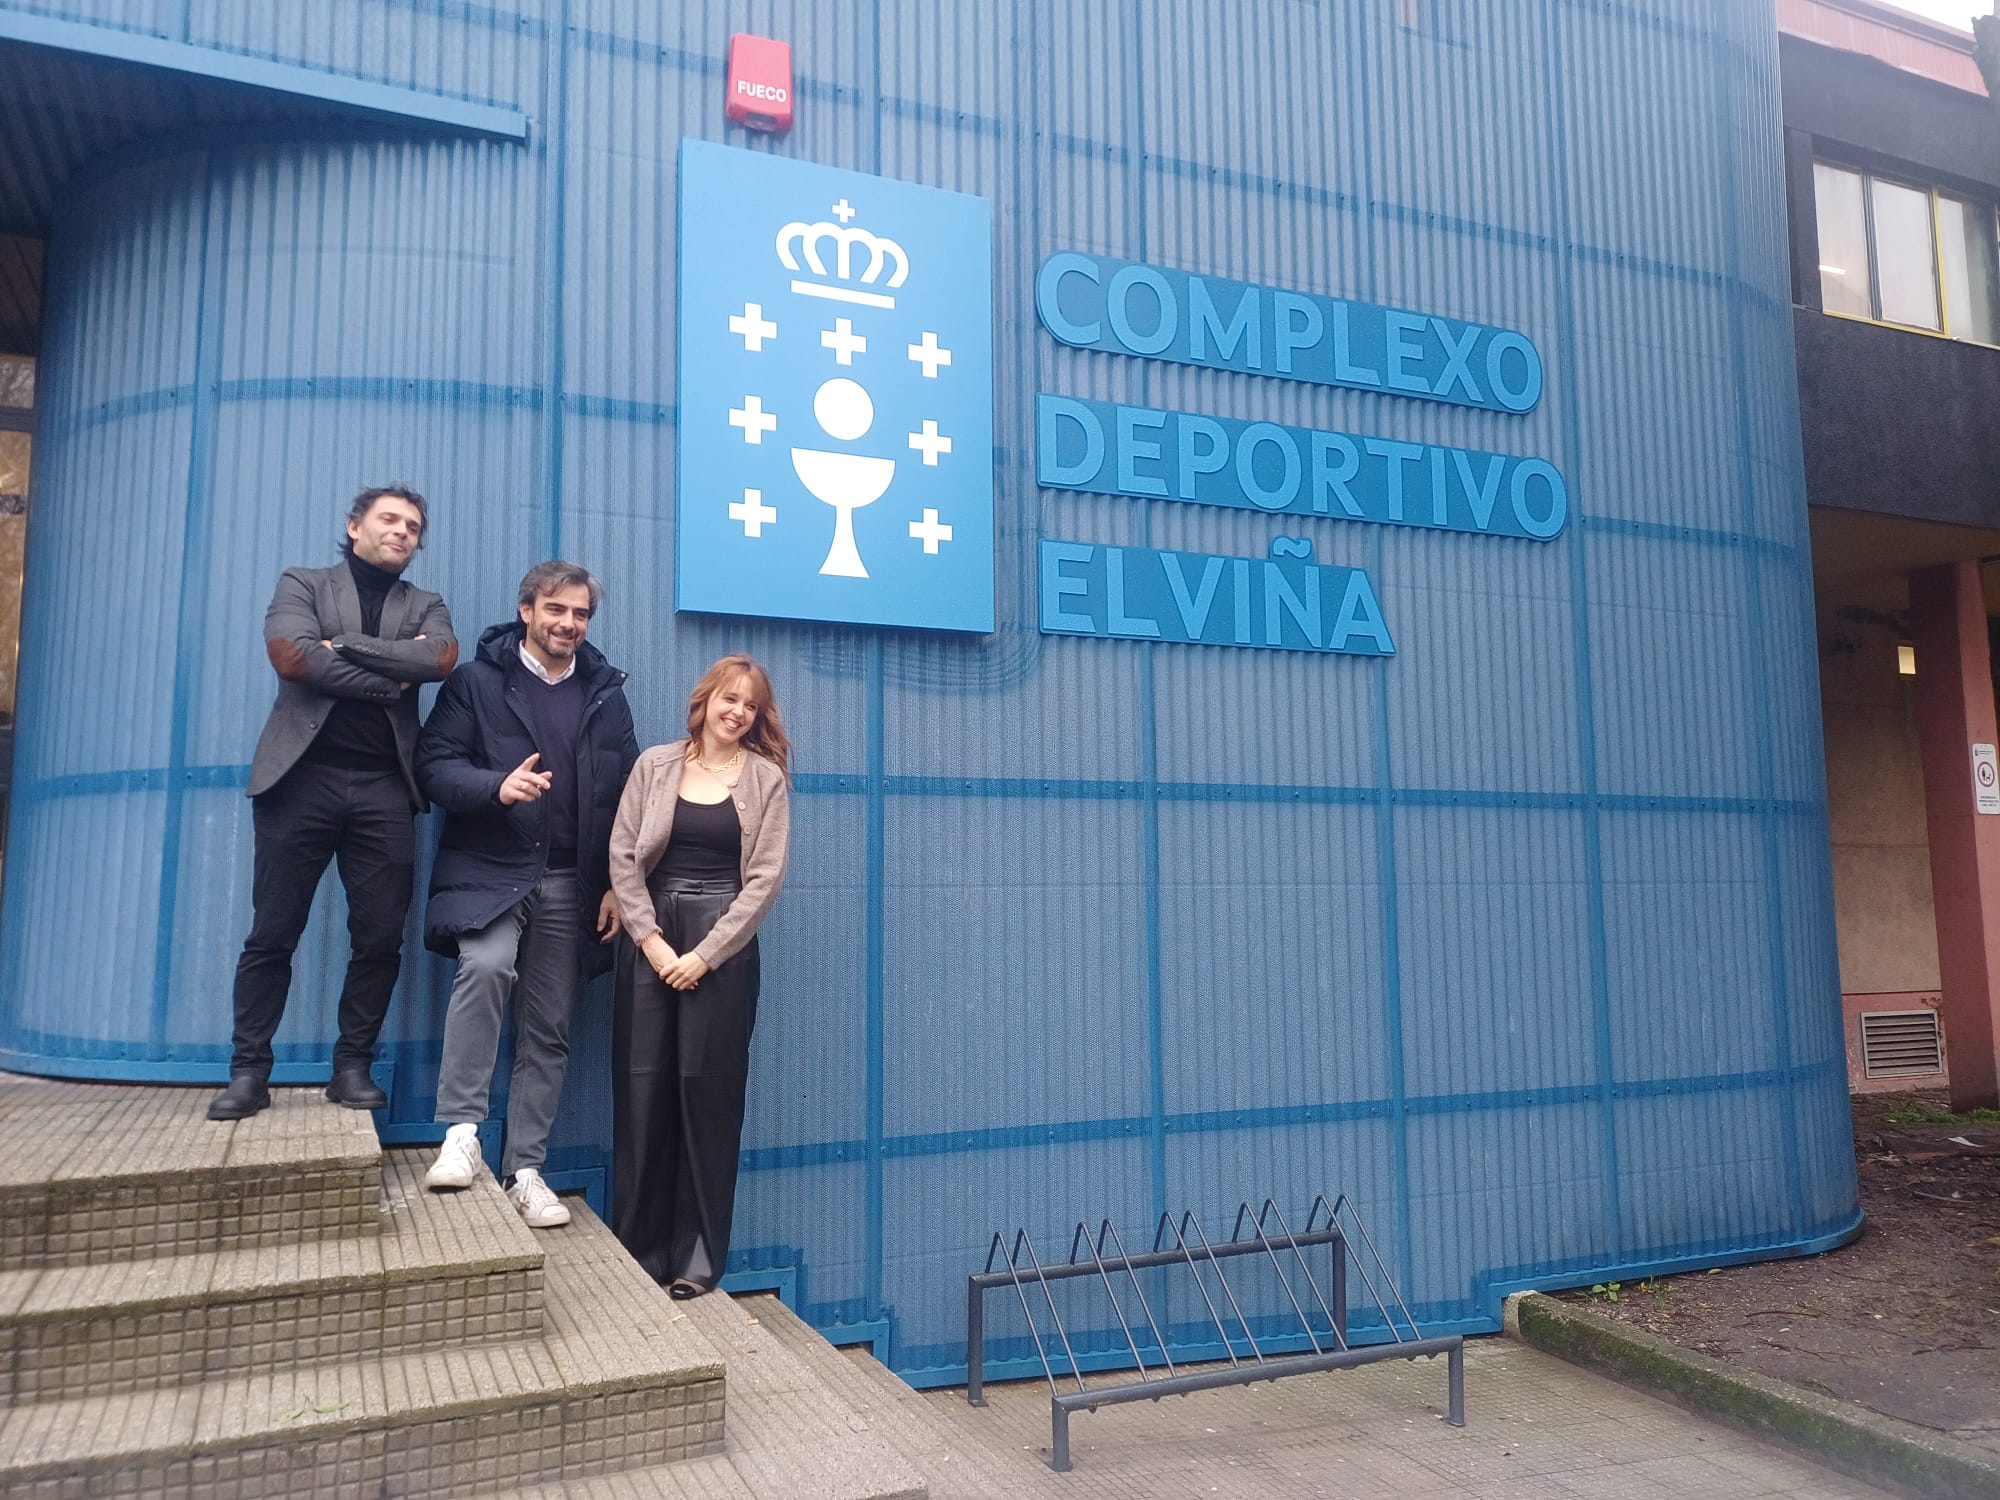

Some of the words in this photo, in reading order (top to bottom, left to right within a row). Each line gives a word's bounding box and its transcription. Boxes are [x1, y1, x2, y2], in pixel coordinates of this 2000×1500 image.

[737, 80, 787, 102] FUECO
[1037, 253, 1543, 413] COMPLEXO
[1039, 394, 1567, 537] DEPORTIVO
[1041, 536, 1396, 653] ELVIÑA
